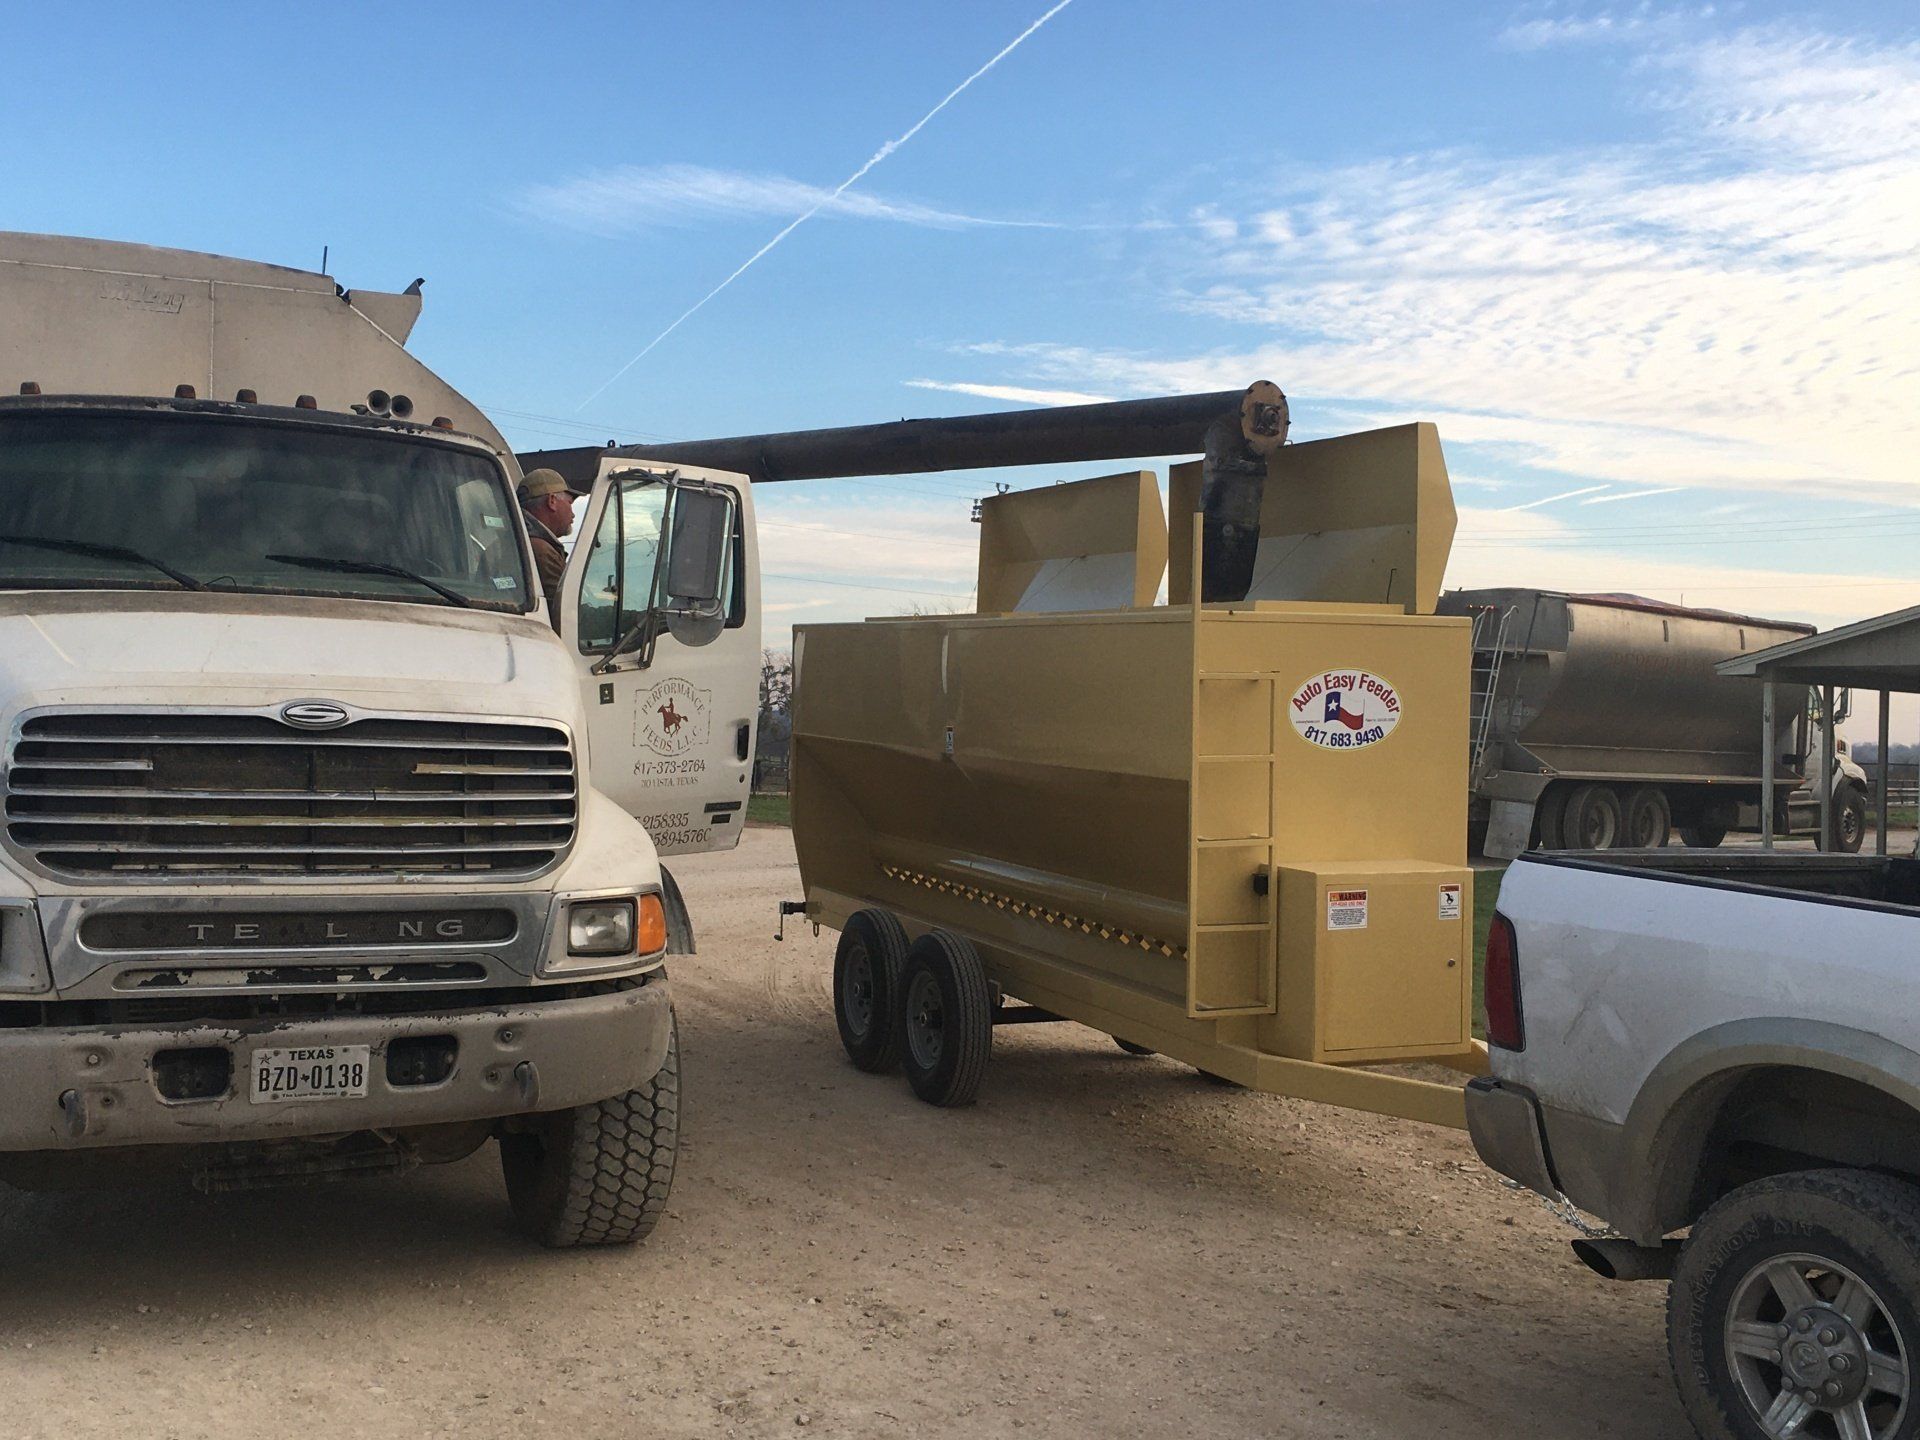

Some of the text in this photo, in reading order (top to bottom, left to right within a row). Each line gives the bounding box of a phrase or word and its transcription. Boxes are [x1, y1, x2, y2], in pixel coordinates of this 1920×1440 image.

[641, 682, 705, 715] PERFORMANCE
[1292, 673, 1400, 713] Auto Easy Feeder
[1304, 725, 1384, 747] 817.683.9430
[633, 759, 706, 776] 817-373-2764
[289, 1049, 335, 1060] TEXAS
